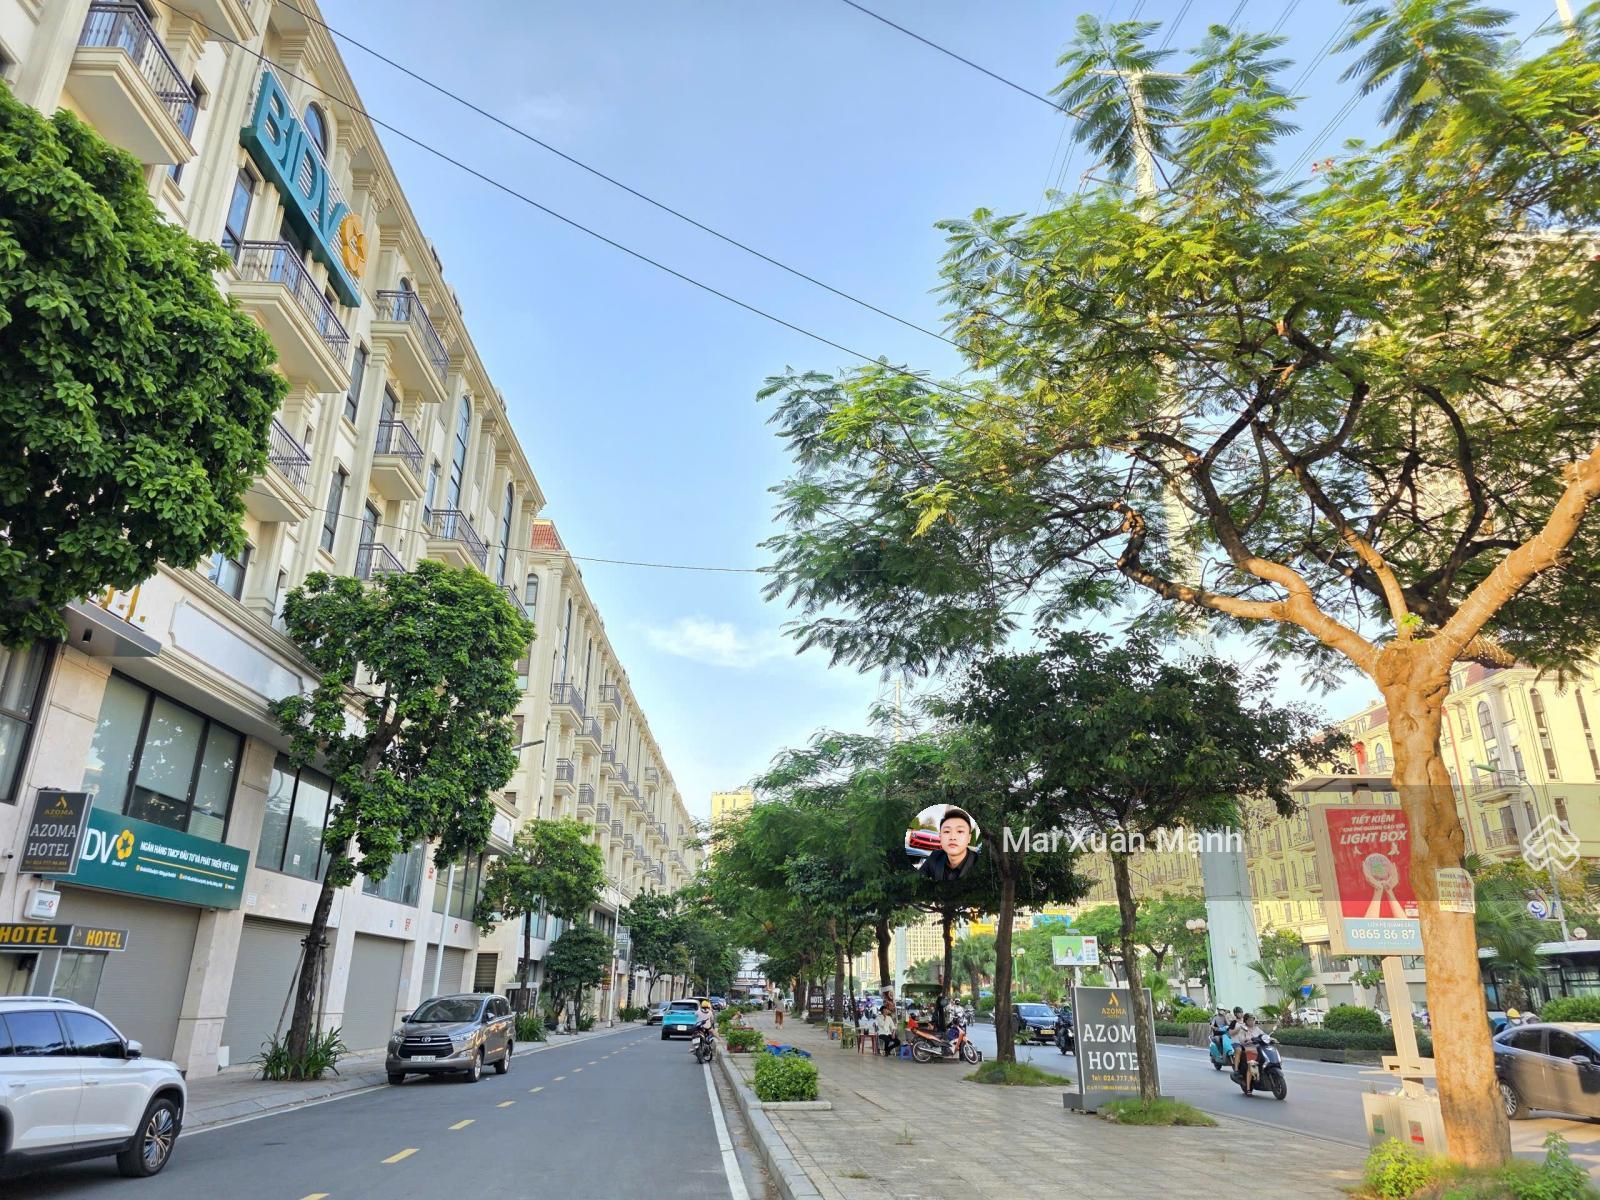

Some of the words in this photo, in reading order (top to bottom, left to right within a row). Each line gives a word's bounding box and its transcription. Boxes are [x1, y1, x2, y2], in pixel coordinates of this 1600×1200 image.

[251, 71, 350, 243] BIDV
[1351, 814, 1370, 824] TIẾT
[1371, 813, 1396, 824] KIỆM
[29, 823, 77, 838] AZOMA
[1340, 832, 1378, 845] LIGHT
[1380, 831, 1408, 842] BOX
[27, 842, 70, 857] HOTEL
[0, 926, 58, 943] HOTEL
[85, 929, 122, 948] HOTEL
[1351, 928, 1380, 939] 0865
[1383, 929, 1398, 940] 86
[1401, 929, 1416, 940] 87
[1101, 1007, 1127, 1015] AZOMA
[1083, 1023, 1137, 1043] AZOM
[1087, 1051, 1140, 1071] HOTE
